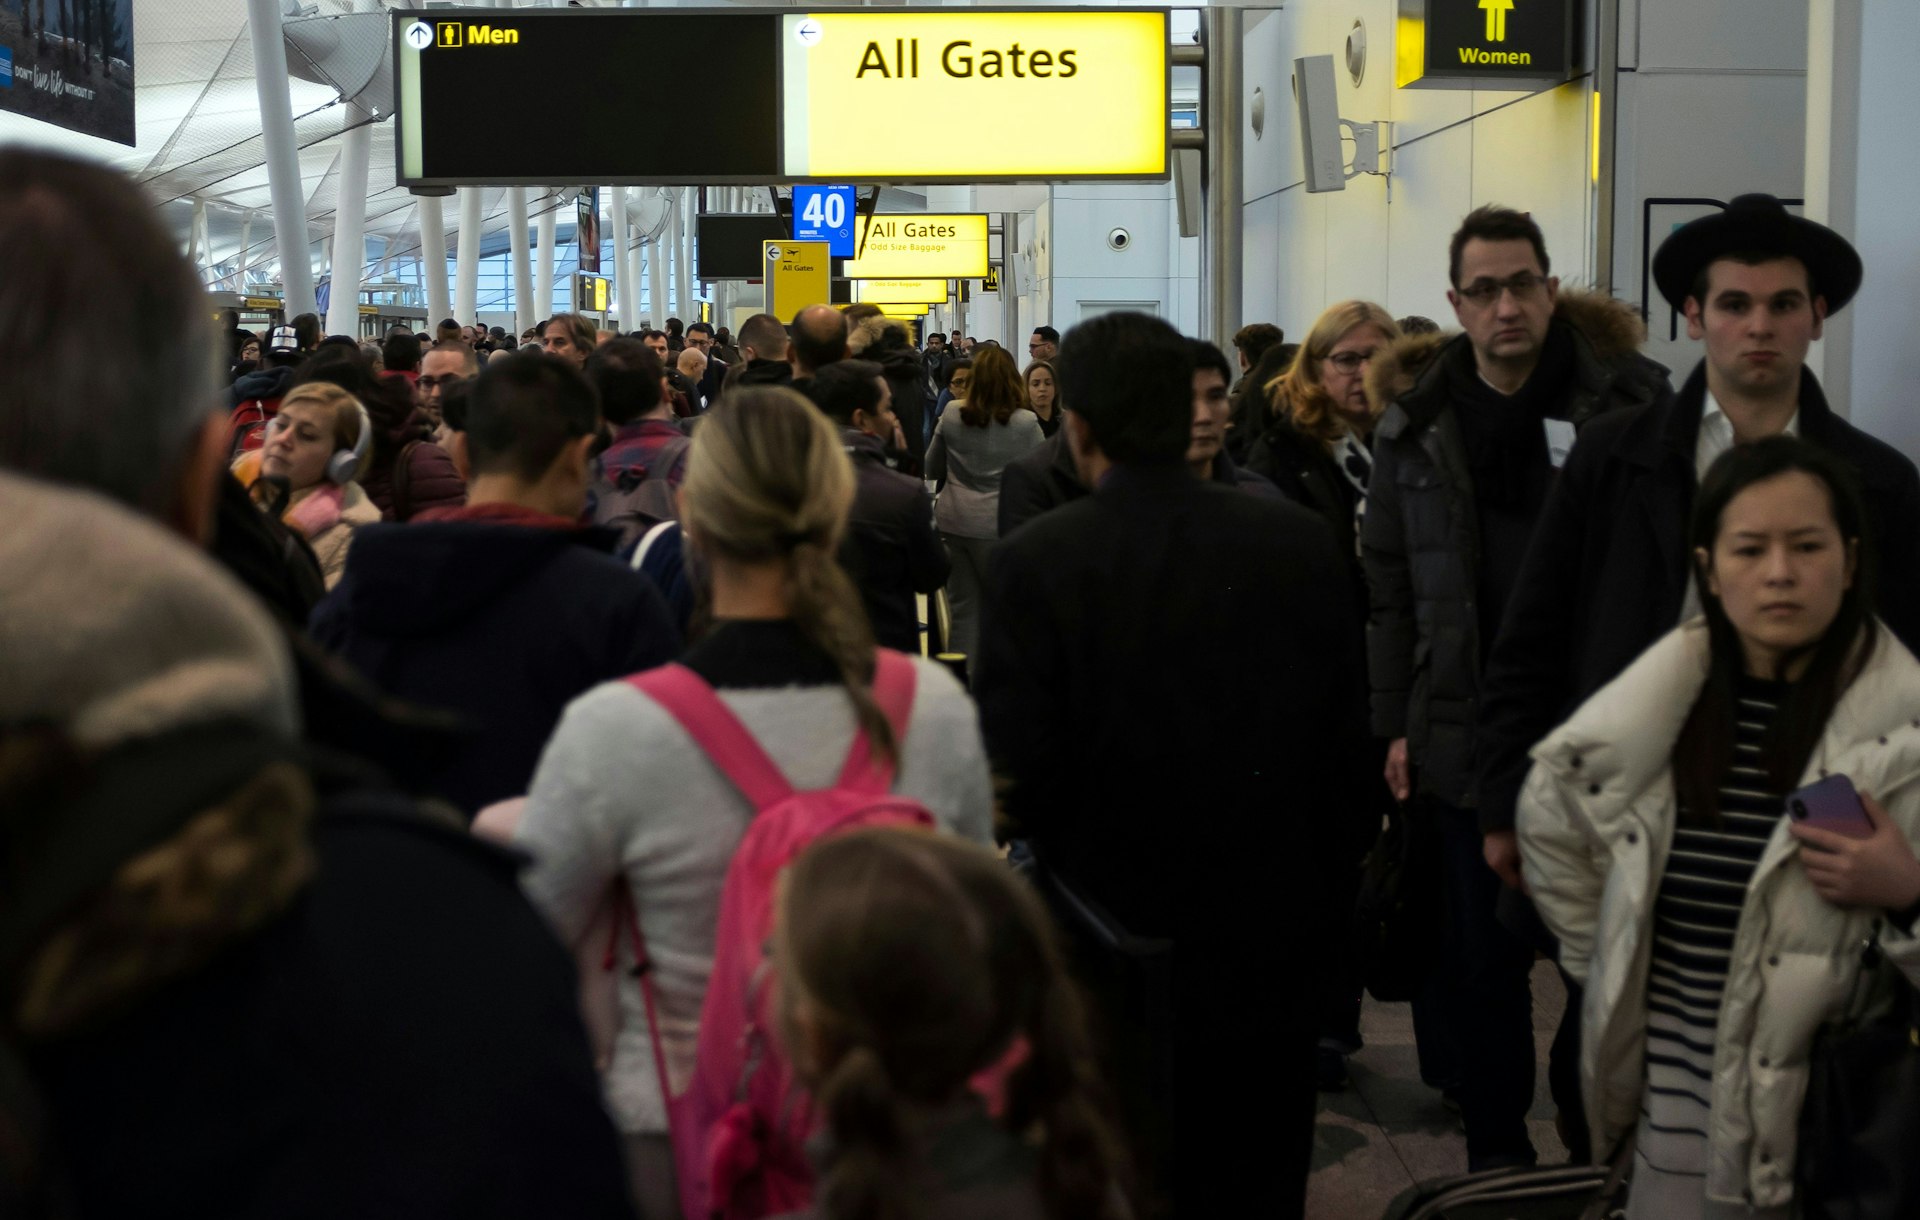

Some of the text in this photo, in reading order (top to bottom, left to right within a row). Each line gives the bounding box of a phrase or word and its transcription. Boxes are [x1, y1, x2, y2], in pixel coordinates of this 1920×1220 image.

[468, 25, 518, 44] Men
[856, 38, 1077, 78] All Gates
[1458, 48, 1531, 64] Women
[14, 65, 33, 81] DON'T
[33, 64, 50, 91] live
[50, 70, 65, 98] life
[64, 82, 87, 99] WITHOUT
[802, 193, 845, 228] 40
[872, 222, 956, 238] All Gates
[870, 243, 946, 253] Odd Size Baggage
